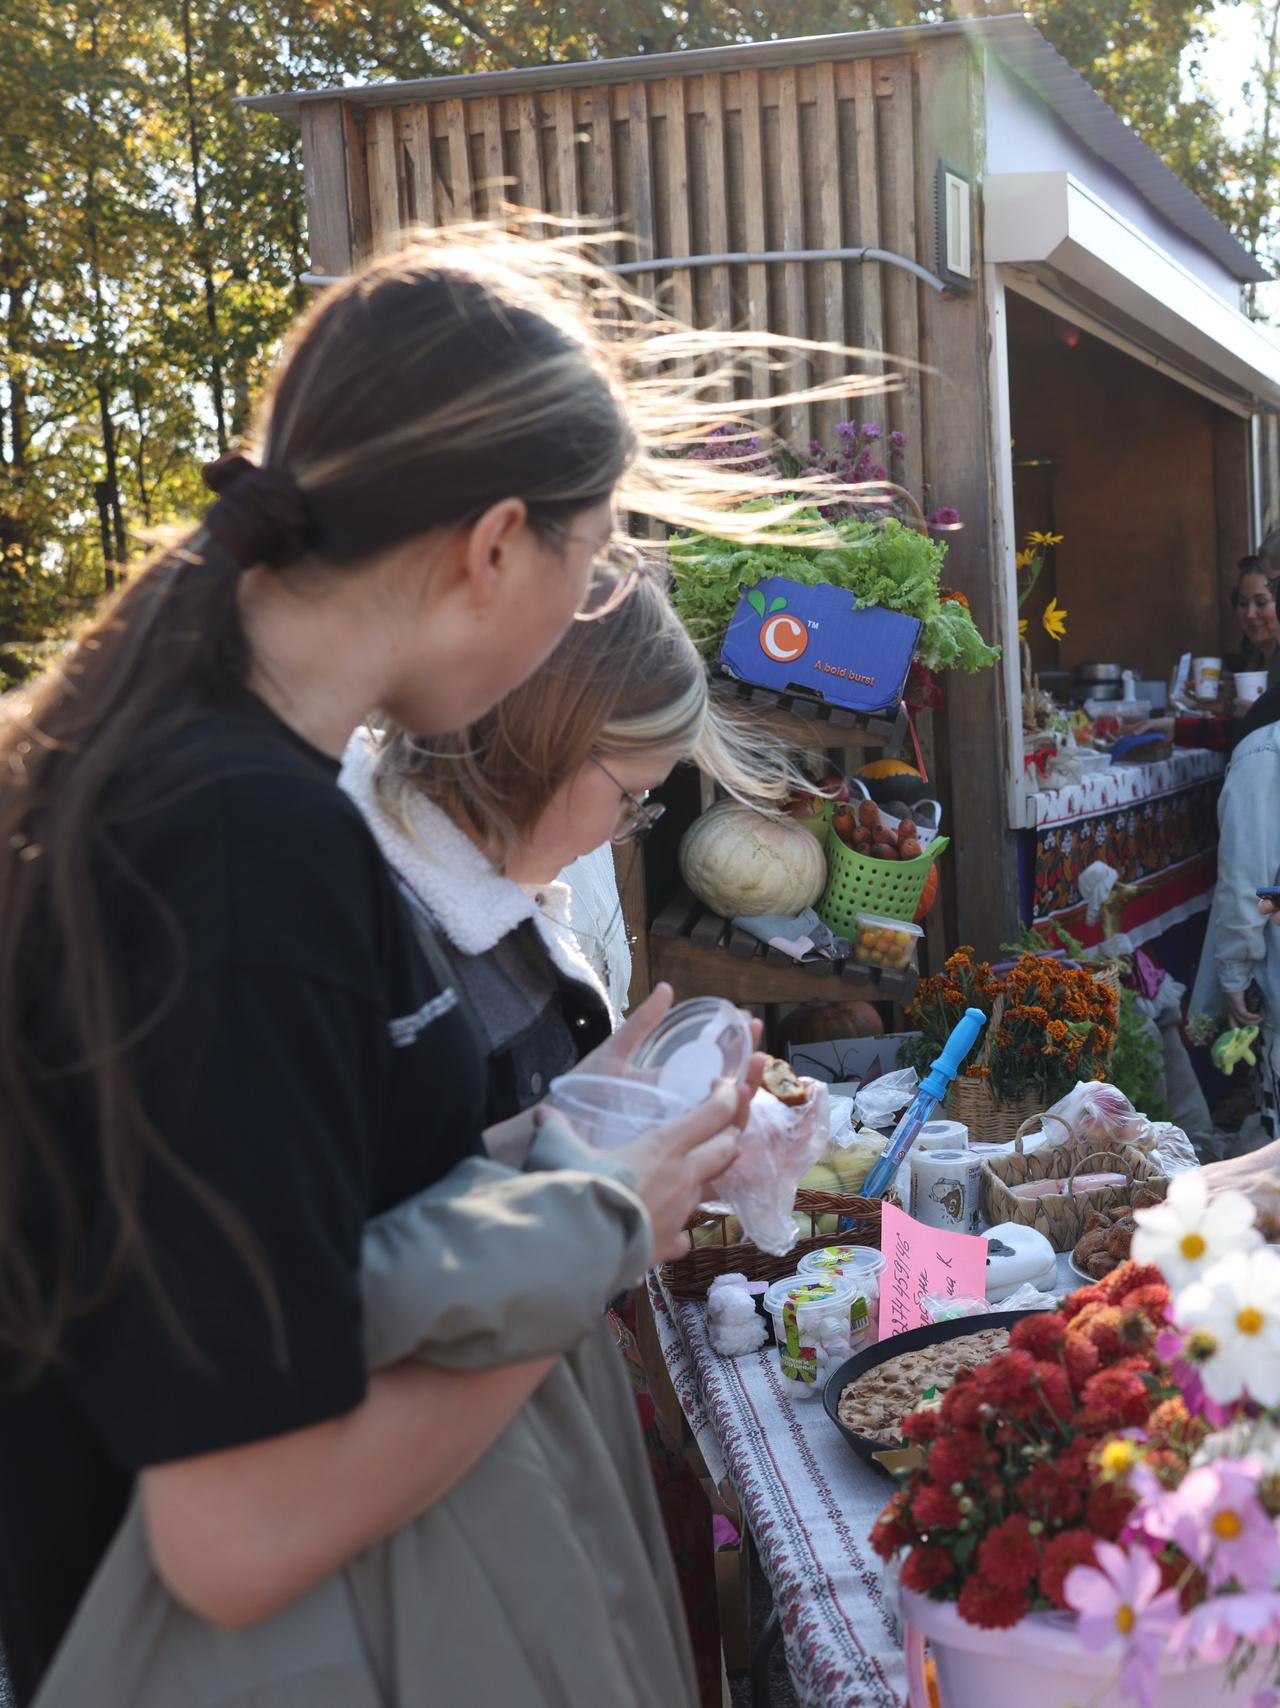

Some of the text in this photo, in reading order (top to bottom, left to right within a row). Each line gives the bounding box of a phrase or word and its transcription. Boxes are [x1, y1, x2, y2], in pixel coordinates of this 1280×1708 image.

[813, 661, 875, 686] A bold burst
